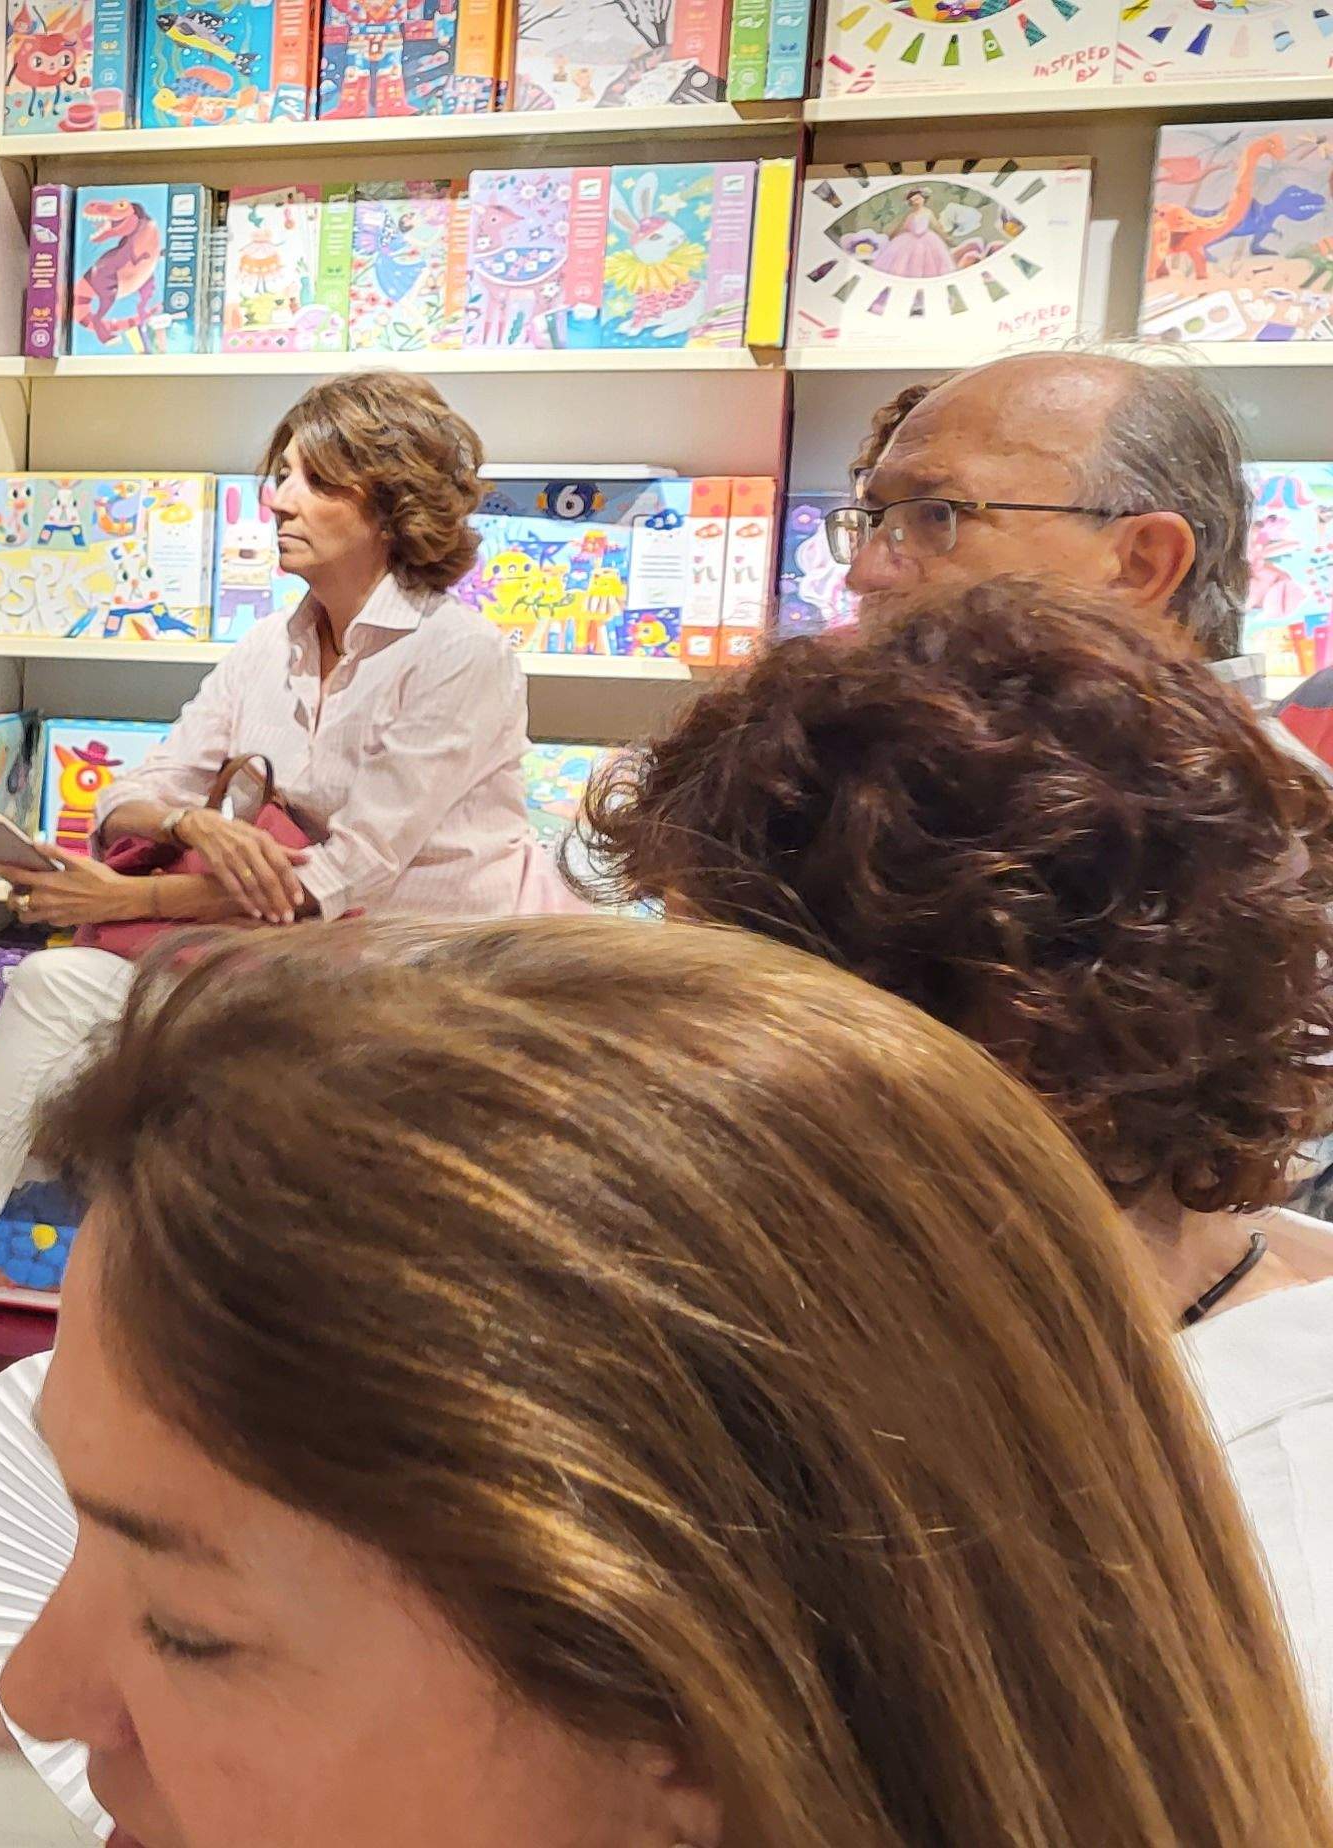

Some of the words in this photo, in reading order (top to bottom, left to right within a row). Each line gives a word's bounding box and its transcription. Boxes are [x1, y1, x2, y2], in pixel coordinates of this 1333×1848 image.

[1034, 45, 1110, 78] INSPIRED
[1076, 66, 1100, 83] BY
[556, 484, 584, 518] 6
